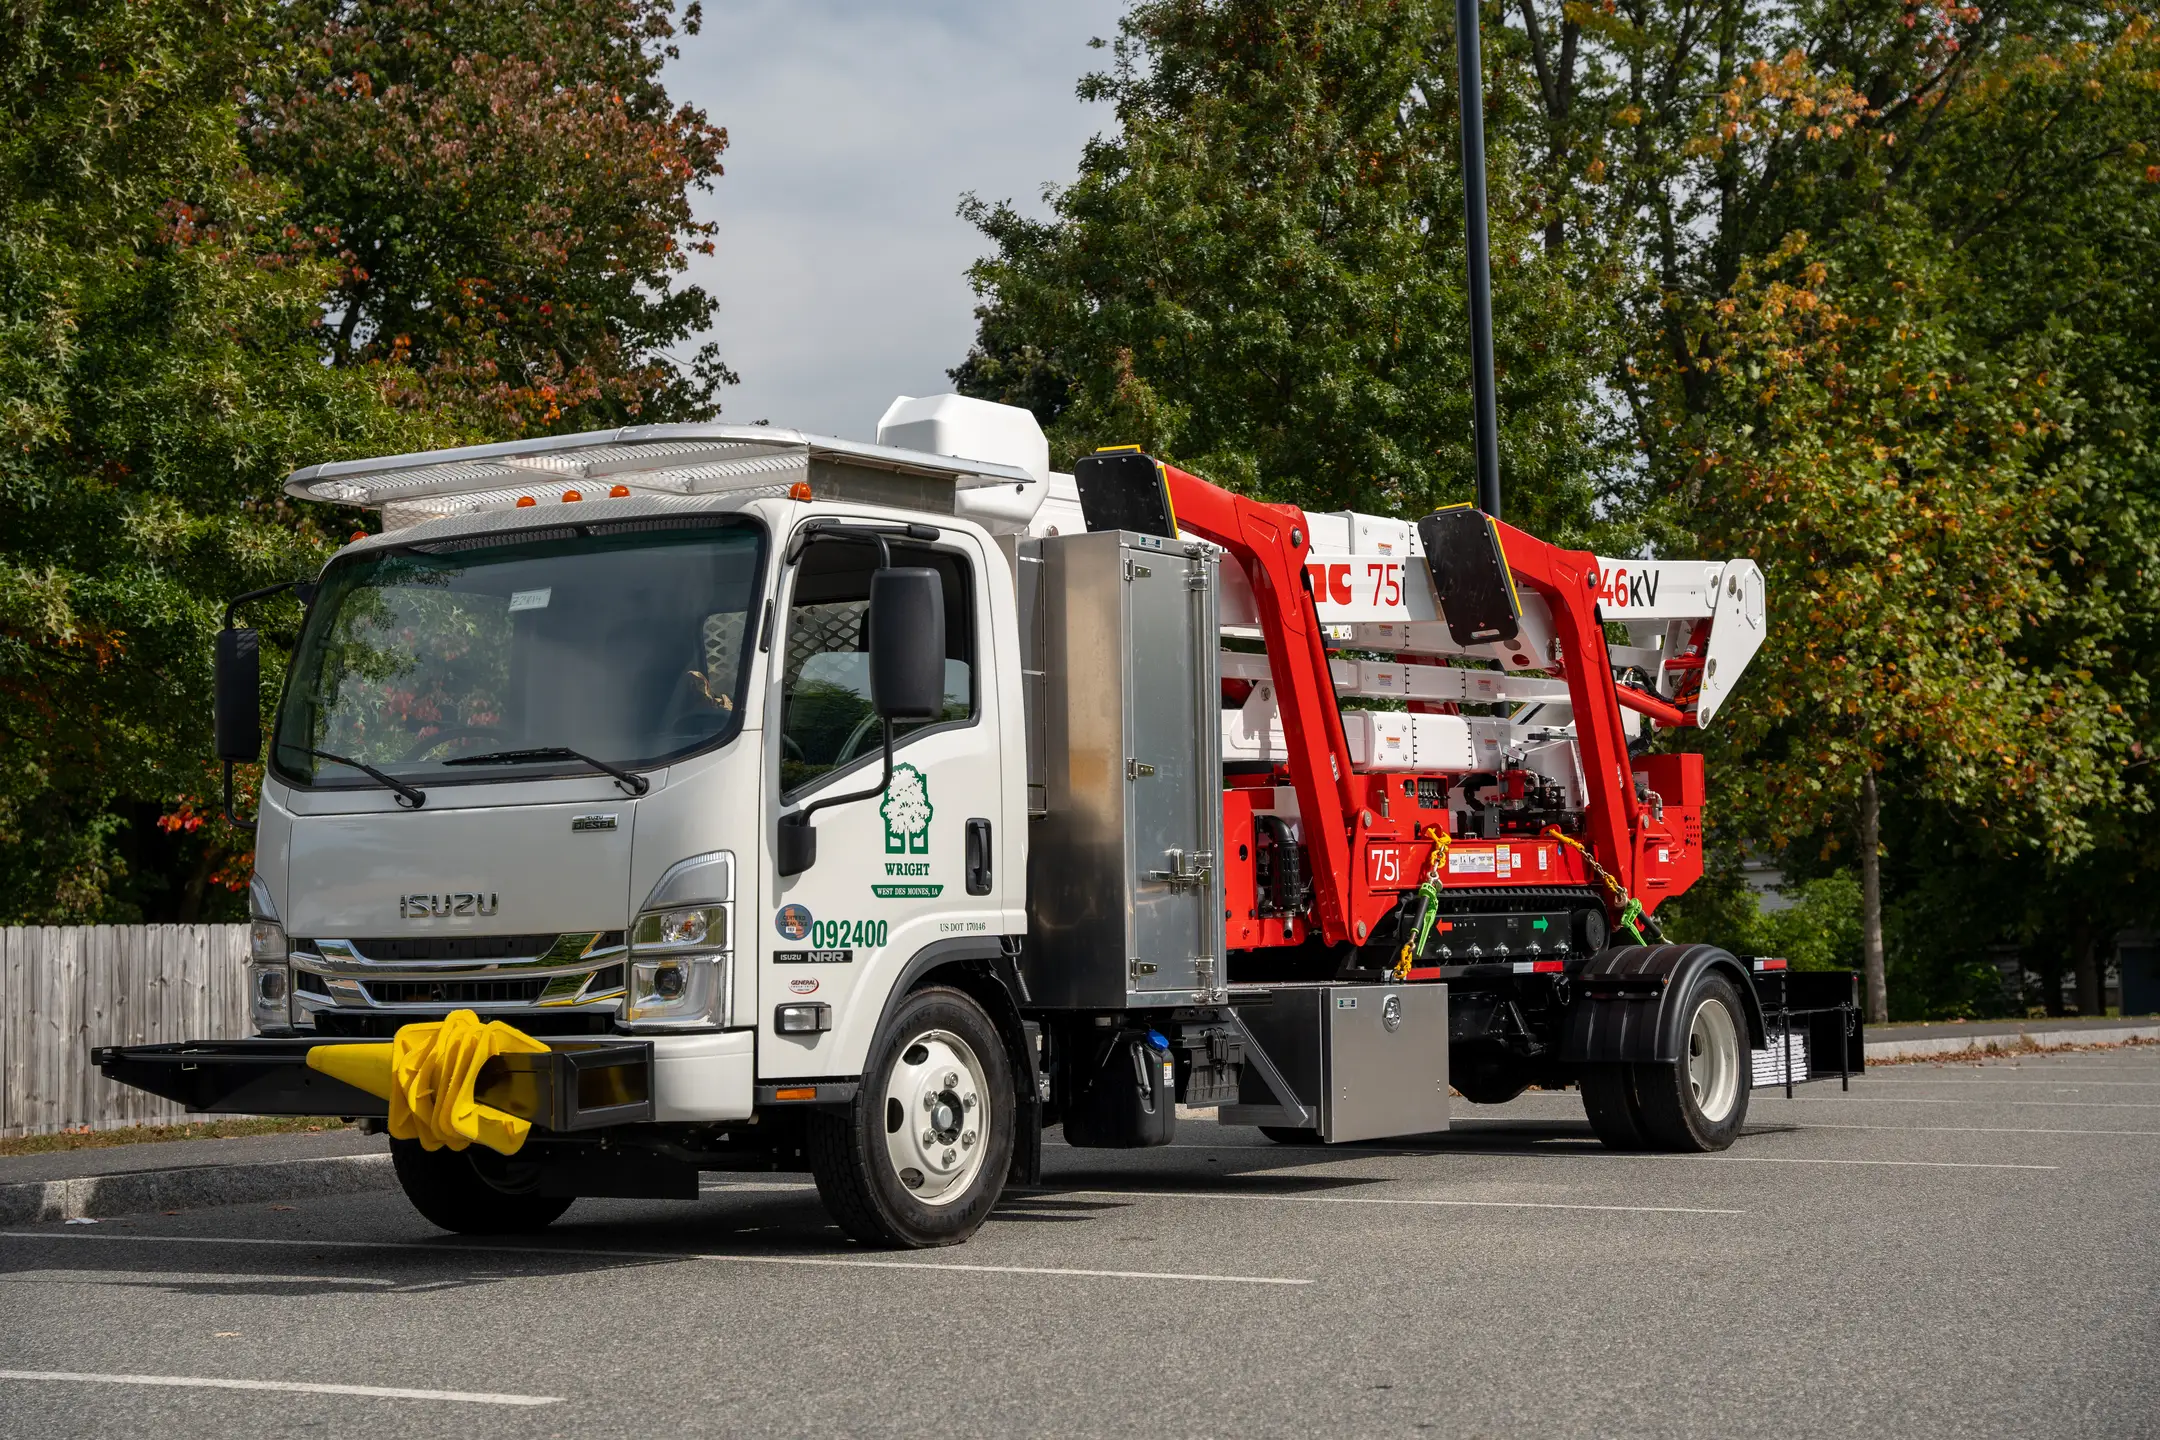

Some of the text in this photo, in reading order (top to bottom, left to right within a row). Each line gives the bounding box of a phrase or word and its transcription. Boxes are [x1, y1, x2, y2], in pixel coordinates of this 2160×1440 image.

[1367, 564, 1406, 606] 75i
[572, 821, 616, 830] DIESEL
[885, 863, 930, 876] WRIGHT
[1371, 849, 1400, 881] 75i
[877, 888, 893, 896] WEST
[894, 888, 906, 896] DES
[907, 887, 931, 897] MOINES,
[400, 891, 499, 919] ISUZU
[940, 922, 986, 932] US DOT 170146
[812, 919, 888, 949] 092400
[808, 951, 844, 962] NRR
